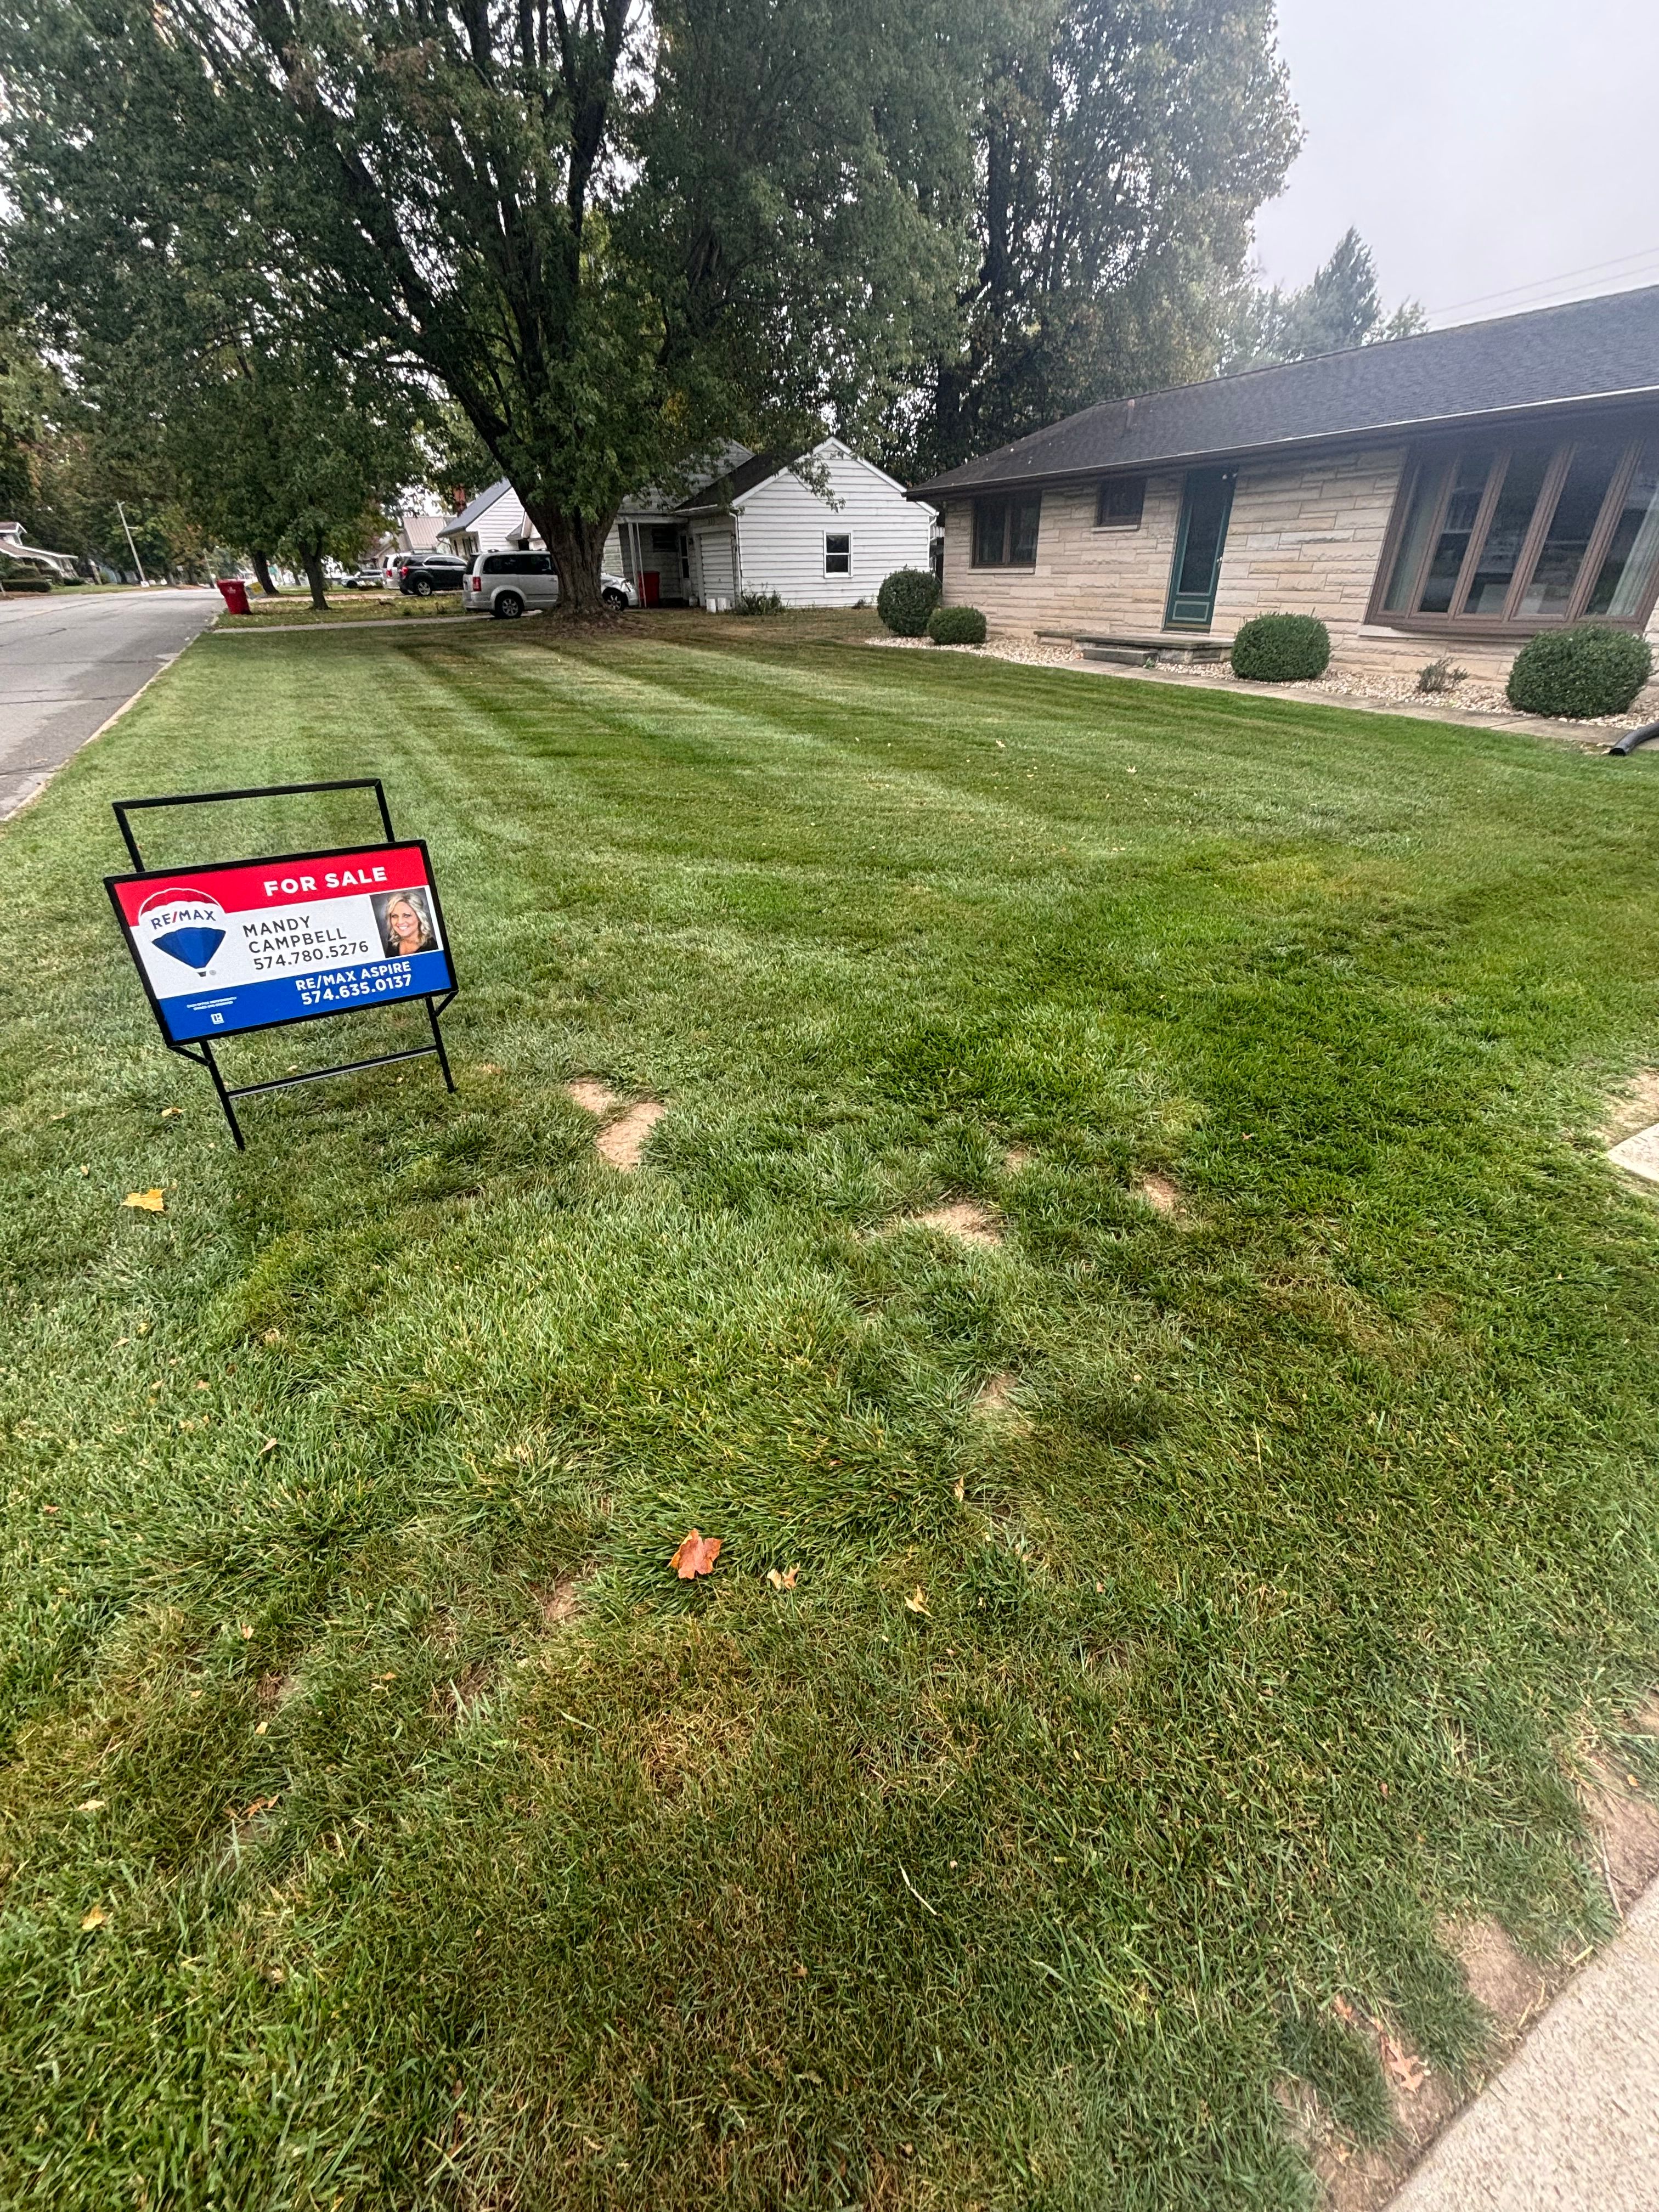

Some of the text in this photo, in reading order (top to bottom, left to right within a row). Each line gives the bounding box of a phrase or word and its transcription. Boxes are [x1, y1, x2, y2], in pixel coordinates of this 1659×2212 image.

[263, 866, 387, 896] FOR SALE
[150, 910, 216, 930] RE/MAX
[242, 916, 310, 938] MANDY
[249, 928, 347, 953] CAMPBELL
[253, 941, 369, 970] 574.780.5276
[295, 961, 411, 991] RE/MAX ASPIRE
[301, 974, 411, 1005] 574.635.0137
